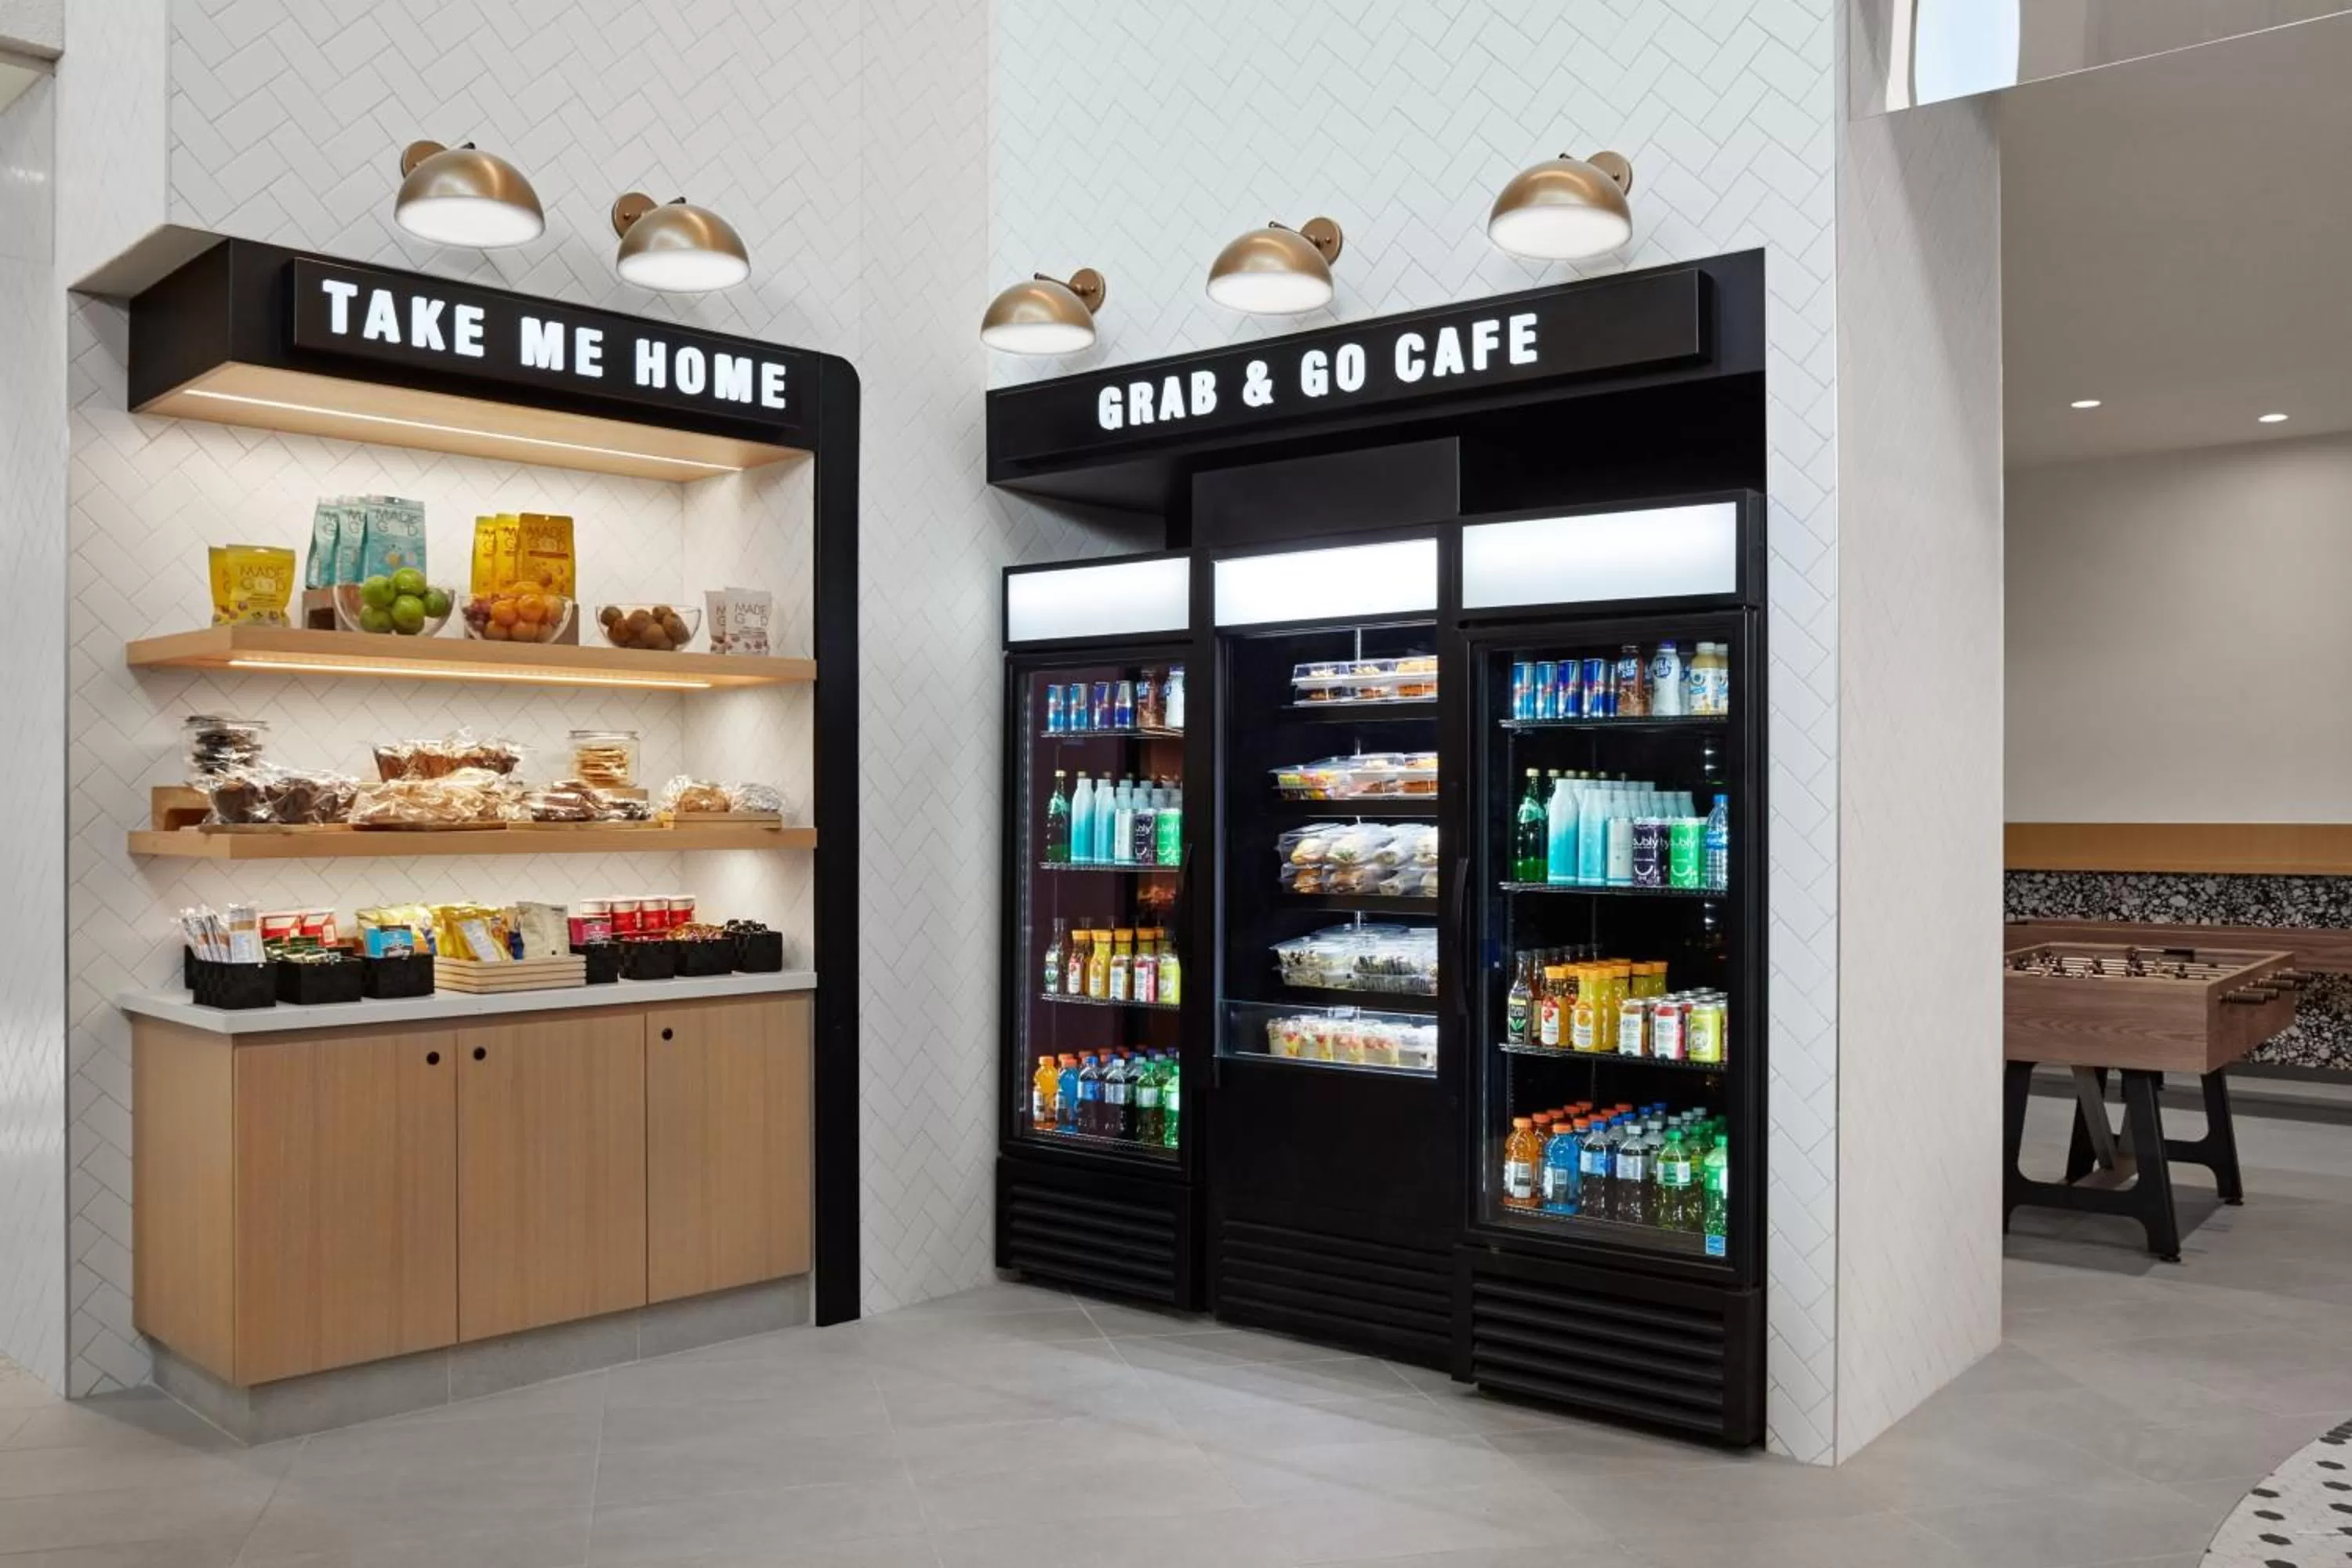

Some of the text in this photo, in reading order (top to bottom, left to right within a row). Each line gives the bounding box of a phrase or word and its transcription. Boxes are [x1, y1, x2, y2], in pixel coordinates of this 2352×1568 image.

[321, 278, 786, 409] TAKE ME HOME
[1098, 313, 1537, 430] GRAB & GO CAFE
[376, 521, 419, 537] GD
[526, 526, 565, 539] MADE
[239, 565, 285, 579] MADE
[734, 612, 769, 627] GD
